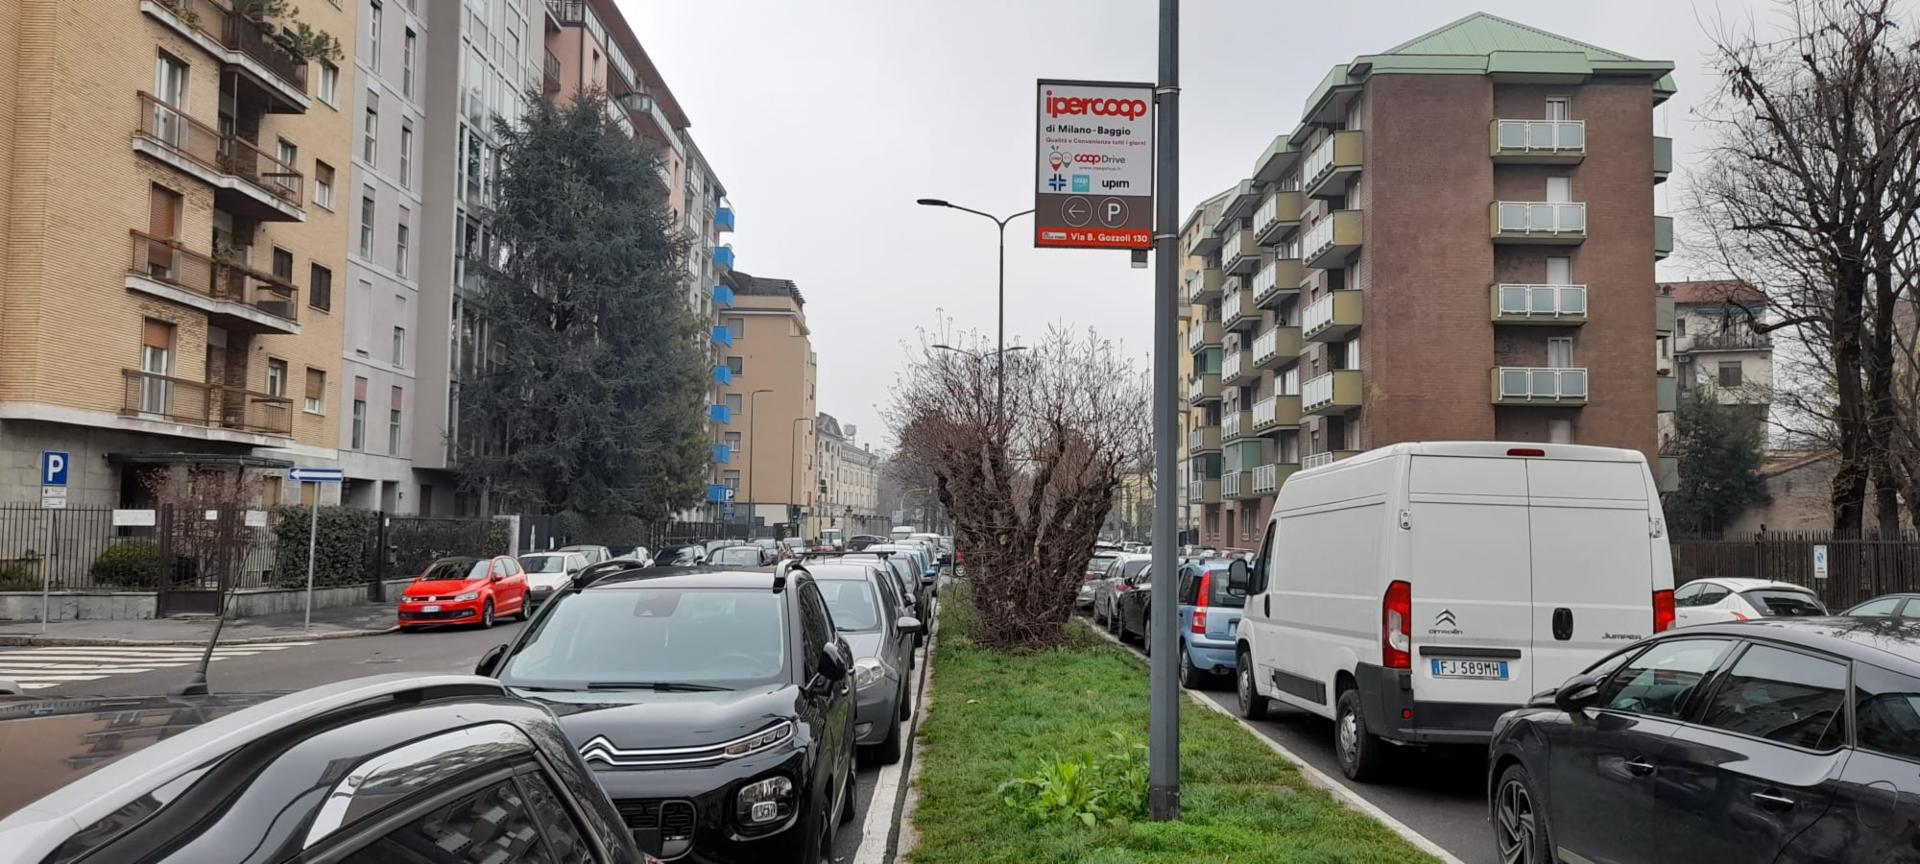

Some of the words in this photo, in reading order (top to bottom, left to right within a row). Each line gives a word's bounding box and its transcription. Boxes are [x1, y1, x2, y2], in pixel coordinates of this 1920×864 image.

[1046, 90, 1147, 121] ipercoop
[1046, 124, 1055, 133] di
[1074, 154, 1101, 165] coop
[1102, 155, 1125, 164] Drive
[1102, 179, 1129, 190] upim
[1108, 203, 1121, 221] P
[1071, 233, 1085, 241] Via
[1087, 233, 1096, 241] B.
[1098, 234, 1131, 243] Gozzoli
[1133, 235, 1148, 243] 130
[48, 454, 64, 481] P
[725, 489, 734, 500] P
[1440, 661, 1457, 674] FJ
[1460, 662, 1500, 675] 589MH
